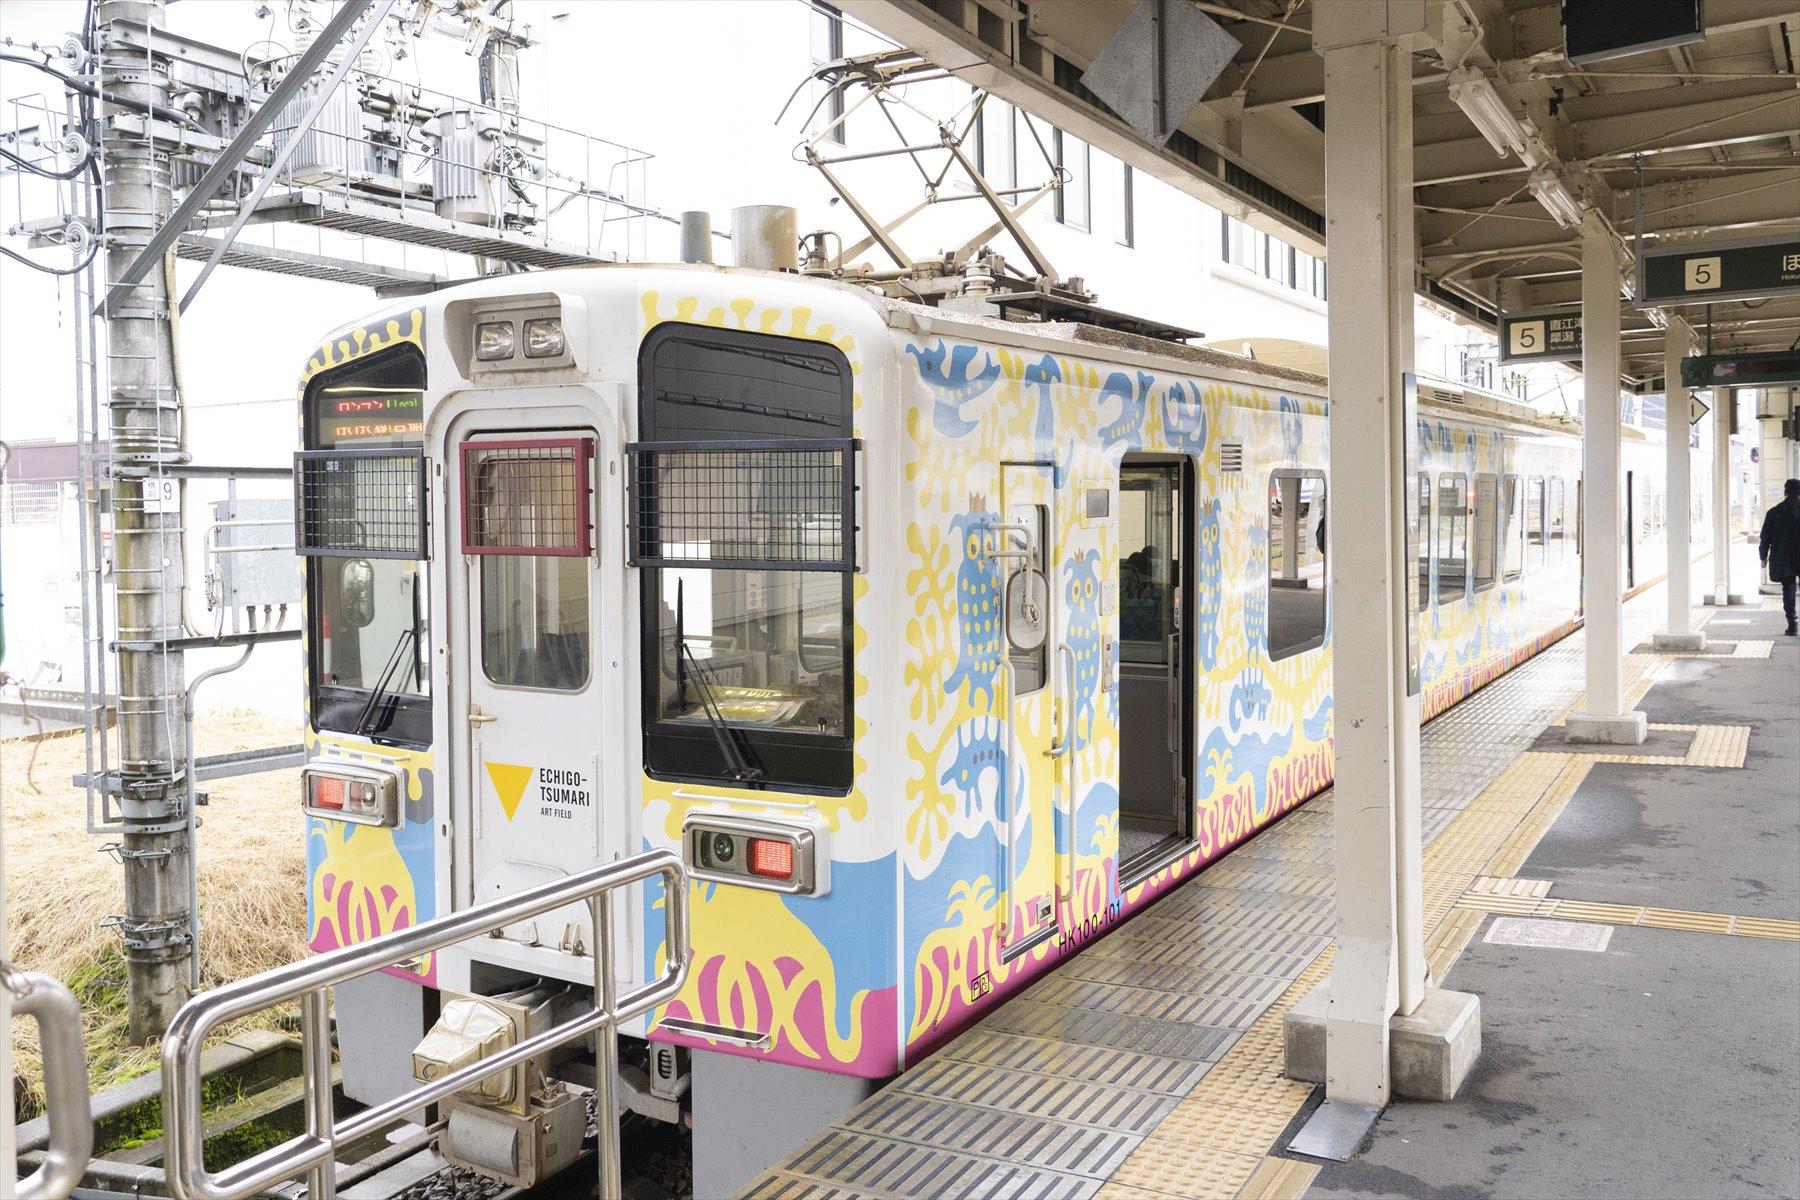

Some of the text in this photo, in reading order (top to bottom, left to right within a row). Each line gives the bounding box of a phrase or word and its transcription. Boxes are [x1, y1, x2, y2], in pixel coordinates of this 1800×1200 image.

[1695, 264, 1711, 284] 5
[1520, 327, 1535, 348] 5
[163, 482, 172, 501] 9
[539, 767, 588, 787] ECHIGO-
[540, 786, 590, 807] TSUMARI
[540, 807, 573, 820] ART FIELD
[1058, 899, 1122, 956] HK100-101
